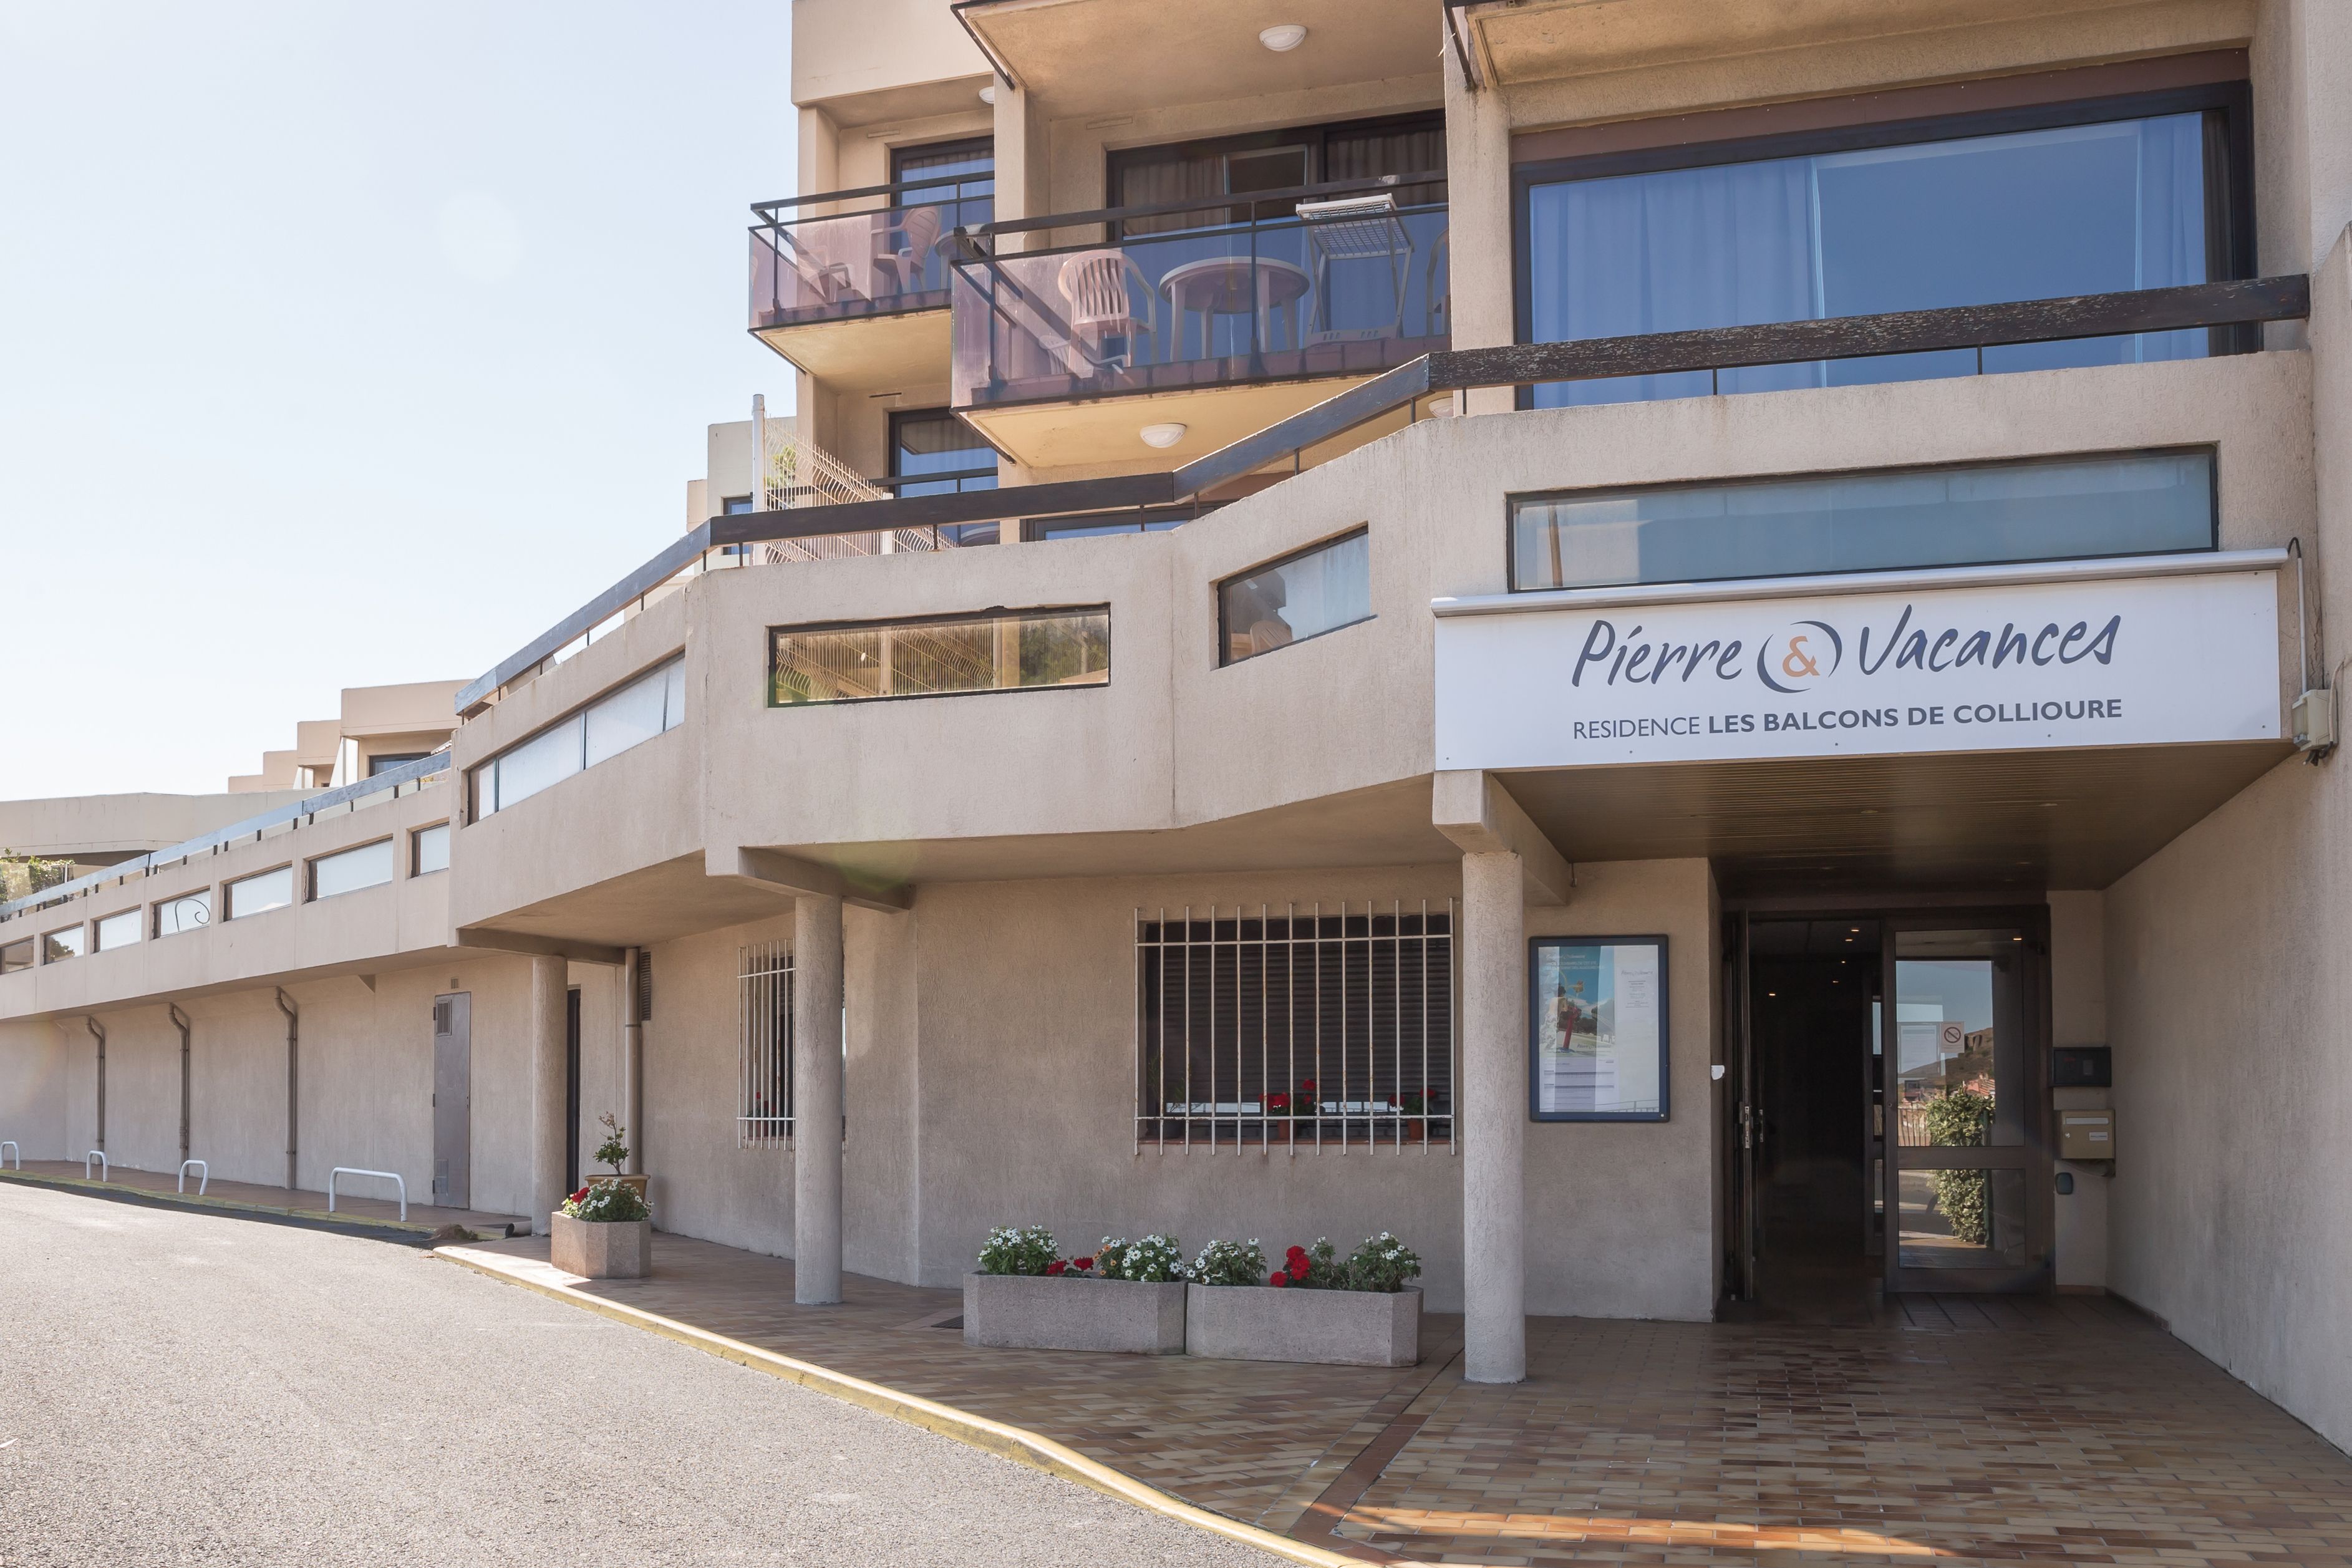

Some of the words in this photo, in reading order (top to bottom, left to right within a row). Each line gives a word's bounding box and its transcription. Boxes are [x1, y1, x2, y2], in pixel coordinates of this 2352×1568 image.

[1572, 619, 1743, 687] Pierre
[1782, 636, 1820, 678] &
[1859, 604, 2121, 675] Vacances
[1574, 717, 1701, 739] RESIDENCE
[1708, 714, 1755, 734] LES
[1764, 709, 1899, 732] BALCONS
[1908, 706, 1945, 726] DE
[1953, 699, 2122, 725] COLLIOURE
